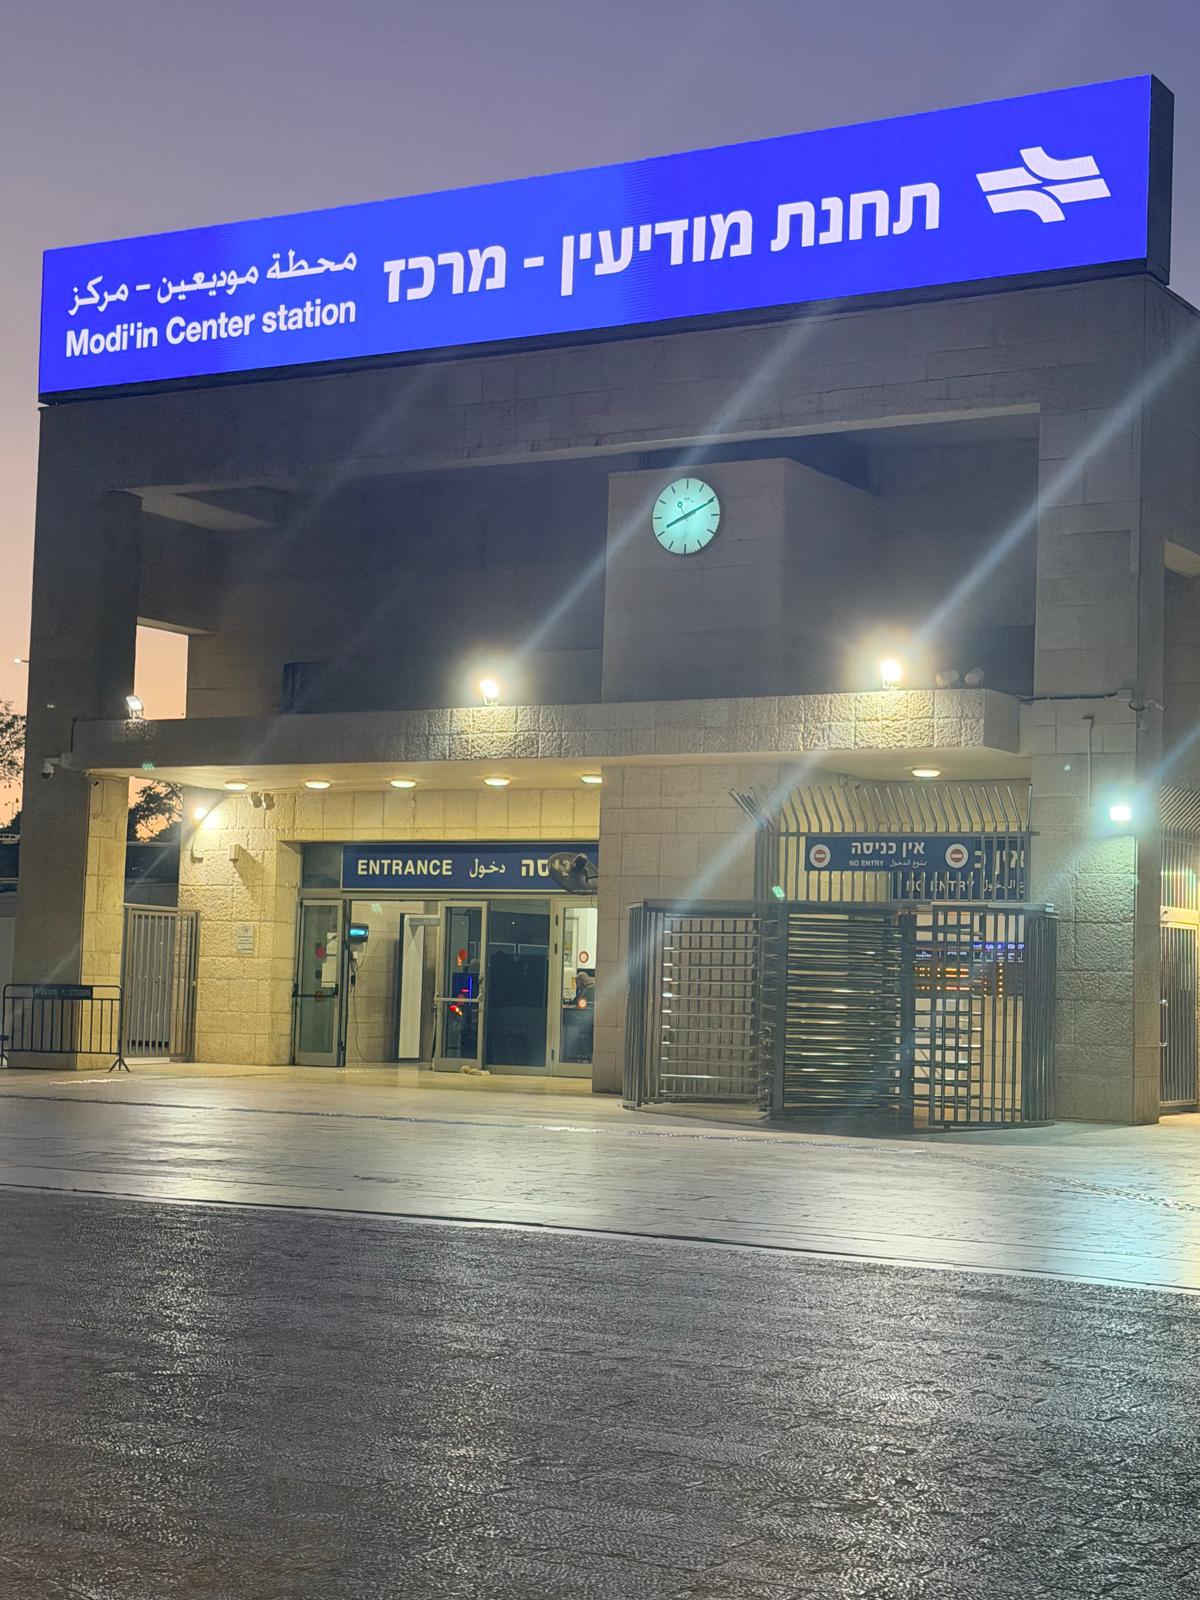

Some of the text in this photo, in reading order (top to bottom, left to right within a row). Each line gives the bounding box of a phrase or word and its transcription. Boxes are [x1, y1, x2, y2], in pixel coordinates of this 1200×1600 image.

[383, 182, 940, 303] תחנת מודיעין - מרכז
[266, 248, 357, 280] محطة
[67, 275, 129, 316] مركز
[156, 265, 259, 304] موديعين
[65, 298, 356, 358] Modi'in Center station
[849, 860, 885, 868] NO ENTRY
[851, 842, 925, 858] אין כניסה
[357, 859, 453, 876] ENTRANCE
[469, 858, 506, 878] دخول
